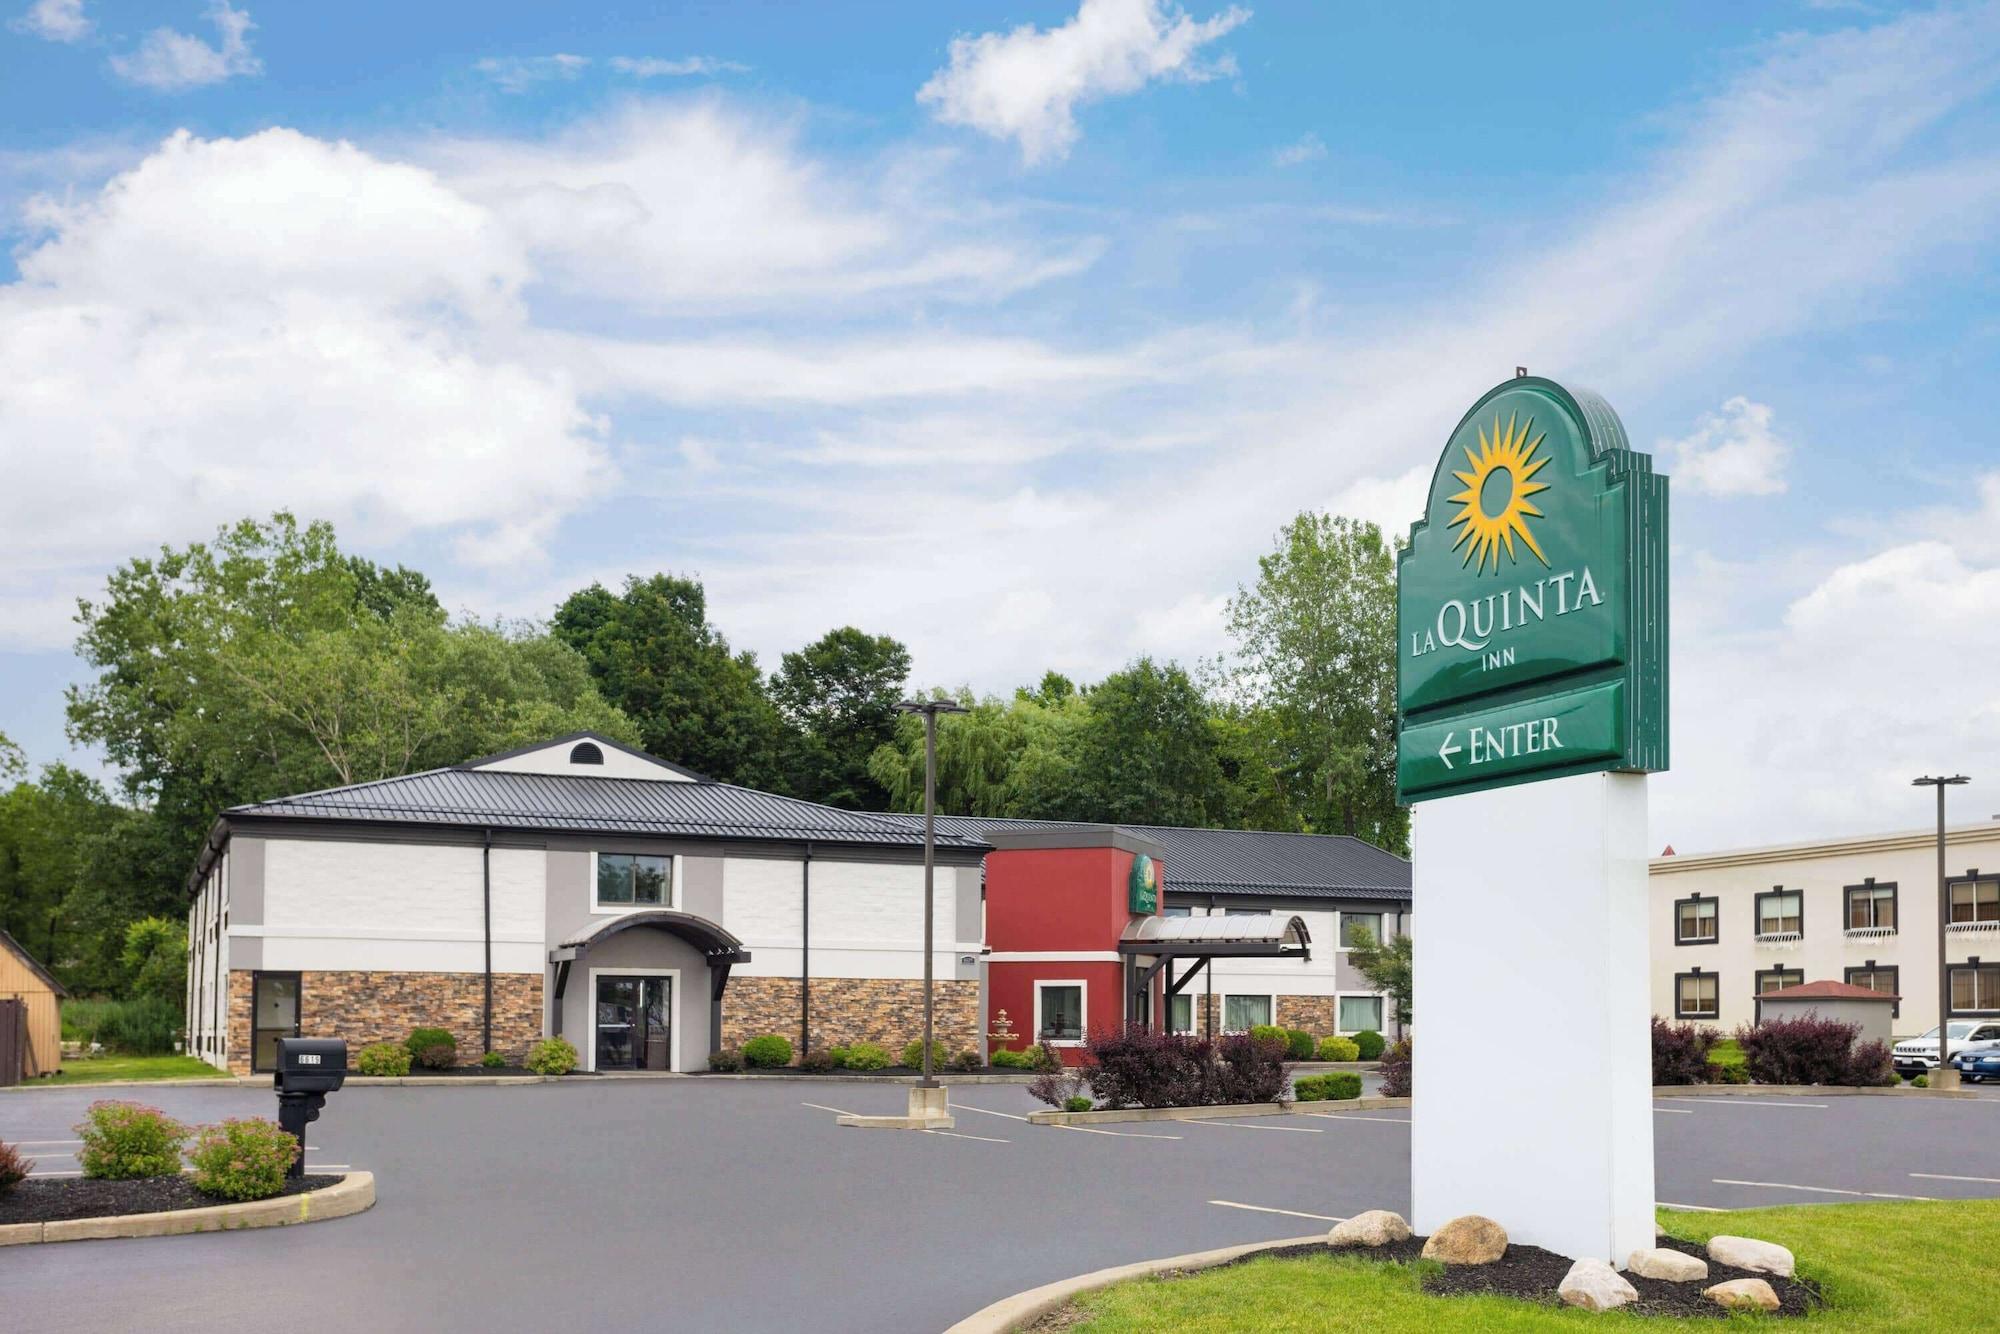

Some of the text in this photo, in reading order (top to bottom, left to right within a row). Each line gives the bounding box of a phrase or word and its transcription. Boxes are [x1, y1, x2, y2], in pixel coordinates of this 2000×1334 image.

[1411, 565, 1604, 657] LA QUINTA
[1482, 646, 1515, 672] INN
[1469, 717, 1564, 765] ENTER
